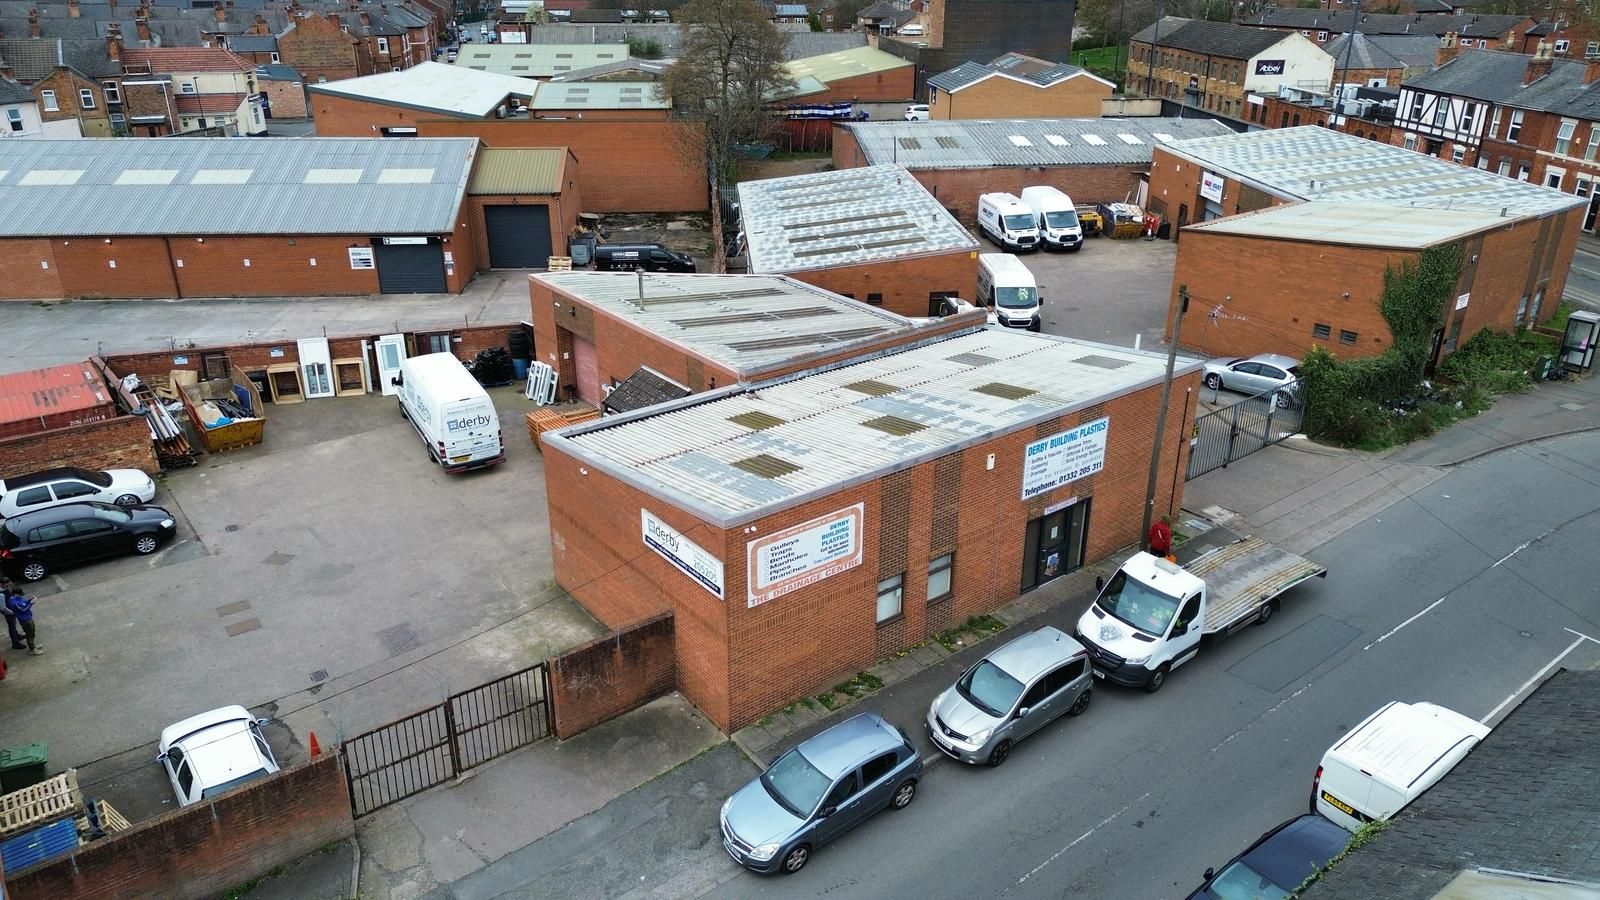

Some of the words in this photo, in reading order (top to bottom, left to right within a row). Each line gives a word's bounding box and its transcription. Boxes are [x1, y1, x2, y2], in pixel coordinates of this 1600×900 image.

[460, 414, 490, 428] derby
[1028, 441, 1048, 456] DERBY
[1050, 430, 1078, 448] BUILDING
[1080, 420, 1106, 438] PLASTICS
[1024, 479, 1058, 497] Telephone:
[1058, 470, 1078, 483] 01332
[1079, 466, 1091, 476] 205
[1092, 461, 1102, 471] 311
[830, 519, 849, 530] DERBY
[655, 524, 680, 552] derby
[822, 526, 849, 540] BUILDING
[822, 533, 849, 547] PLASTICS
[770, 538, 800, 552] Gulleys
[770, 547, 792, 558] Traps
[770, 552, 795, 564] Bends
[770, 552, 808, 570] Manholes
[694, 559, 718, 582] 205205
[769, 564, 791, 576] Pipes
[769, 564, 807, 581] Branches
[751, 594, 769, 606] THE
[773, 574, 821, 596] DRAINAGE
[825, 558, 860, 577] CENTRE
